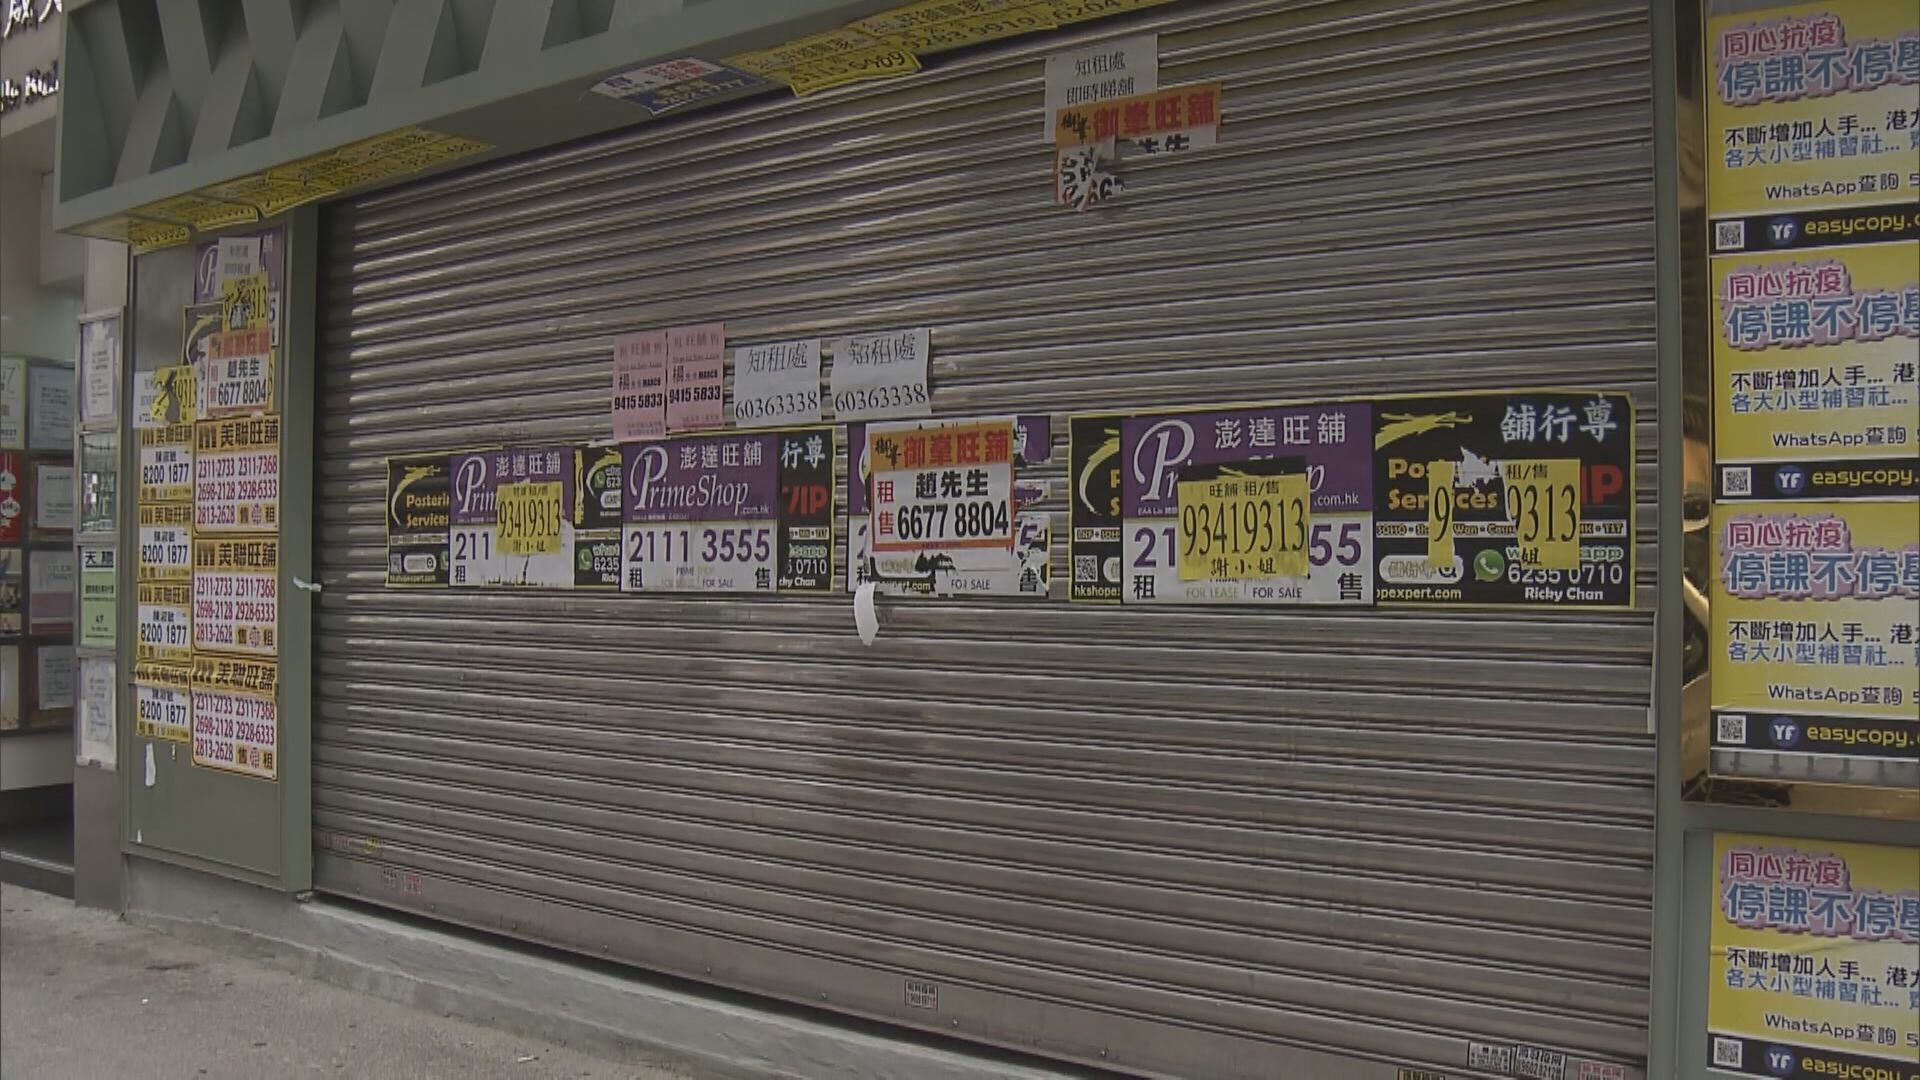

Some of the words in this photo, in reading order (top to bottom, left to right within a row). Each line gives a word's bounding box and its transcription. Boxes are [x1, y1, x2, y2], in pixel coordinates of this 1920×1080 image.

[1723, 20, 1837, 57] 同心抗疫
[1729, 267, 1842, 299] 同心抗疫
[227, 358, 260, 379] 趙先生
[1893, 363, 1919, 383] 港
[218, 381, 240, 405] 6677
[242, 380, 266, 404] 8804
[614, 395, 636, 411] 9415
[637, 393, 663, 408] 5833
[669, 387, 692, 404] 9415
[694, 385, 721, 402] 5833
[835, 384, 926, 413] 60363338
[735, 393, 818, 420] 60363338
[1214, 411, 1347, 449] 澎達旺舖
[143, 466, 164, 484] 8200
[168, 463, 189, 483] 1877
[629, 445, 749, 515] PrimeShop
[916, 469, 989, 499] 趙先生
[1580, 464, 1623, 504] IP
[1779, 472, 1802, 488] YF
[877, 480, 894, 504] 租
[1388, 489, 1497, 510] Serices
[499, 500, 561, 538] 93419313
[878, 511, 894, 536] 售
[897, 503, 948, 540] 6677
[954, 500, 1008, 538] 8804
[1183, 497, 1306, 557] 93419313
[455, 531, 489, 560] 211
[629, 530, 688, 562] 2111
[702, 528, 770, 562] 3555
[1133, 527, 1177, 568] 21
[1308, 523, 1362, 567] 55
[1728, 520, 1843, 548] 同心抗疫
[142, 545, 163, 564] 8200
[167, 545, 188, 564] 1877
[455, 565, 466, 583] 租
[629, 567, 643, 588] 租
[754, 566, 771, 588] 售
[795, 560, 828, 575] 0710
[1210, 557, 1277, 577] 謝小姐
[718, 578, 734, 588] SALE
[794, 577, 815, 588] Chan
[971, 578, 991, 590] SALE
[1133, 575, 1155, 600] 租
[1337, 573, 1363, 601] 售
[1252, 587, 1274, 599] FOR
[1278, 587, 1303, 599] SALE
[1525, 587, 1561, 602] Ricky
[1566, 587, 1604, 600] Chan
[141, 623, 162, 643] 8200
[166, 625, 187, 646] 1877
[1890, 623, 1919, 644] 港
[140, 700, 161, 721] 8200
[165, 705, 186, 725] 1877
[1806, 725, 1919, 747] easycopy.
[1729, 852, 1842, 886] 同心抗疫
